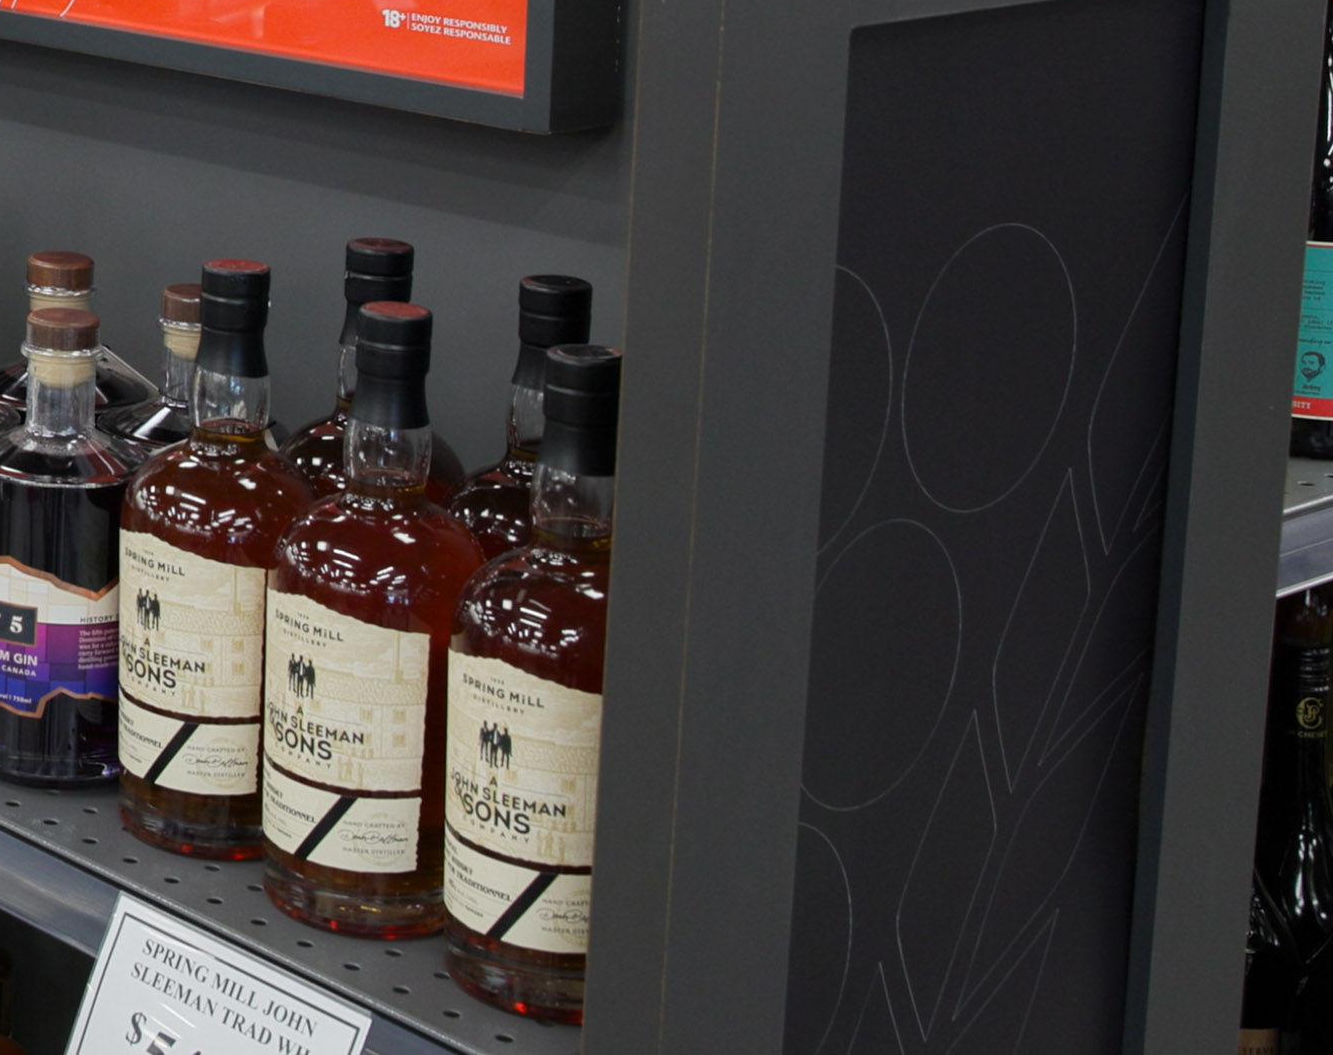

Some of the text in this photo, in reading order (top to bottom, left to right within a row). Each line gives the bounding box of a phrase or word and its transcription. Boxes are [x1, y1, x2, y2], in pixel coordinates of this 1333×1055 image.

[382, 9, 406, 28] 18+
[411, 13, 507, 34] ENJOY RESPONSIBLY
[411, 22, 511, 45] SOYEZ RESPONSABLE
[124, 547, 155, 569] SPRING
[9, 616, 23, 634] 5
[80, 615, 113, 623] HISTORY
[275, 609, 310, 634] SPRING
[144, 638, 151, 646] A
[2, 664, 37, 676] CANADA
[13, 653, 38, 667] GIN
[127, 655, 177, 688] SONS
[139, 648, 205, 674] SLEEMAN
[463, 673, 505, 700] SPRING
[297, 705, 304, 715] A
[275, 723, 332, 760] SONS
[290, 716, 365, 745] SLEEMAN
[489, 777, 498, 787] A
[464, 793, 530, 835] SONS
[483, 788, 567, 818] SLEEMAN
[142, 938, 318, 1038] SPRING MILL JOHN
[130, 962, 273, 1046] SLEEMAN TRAD
